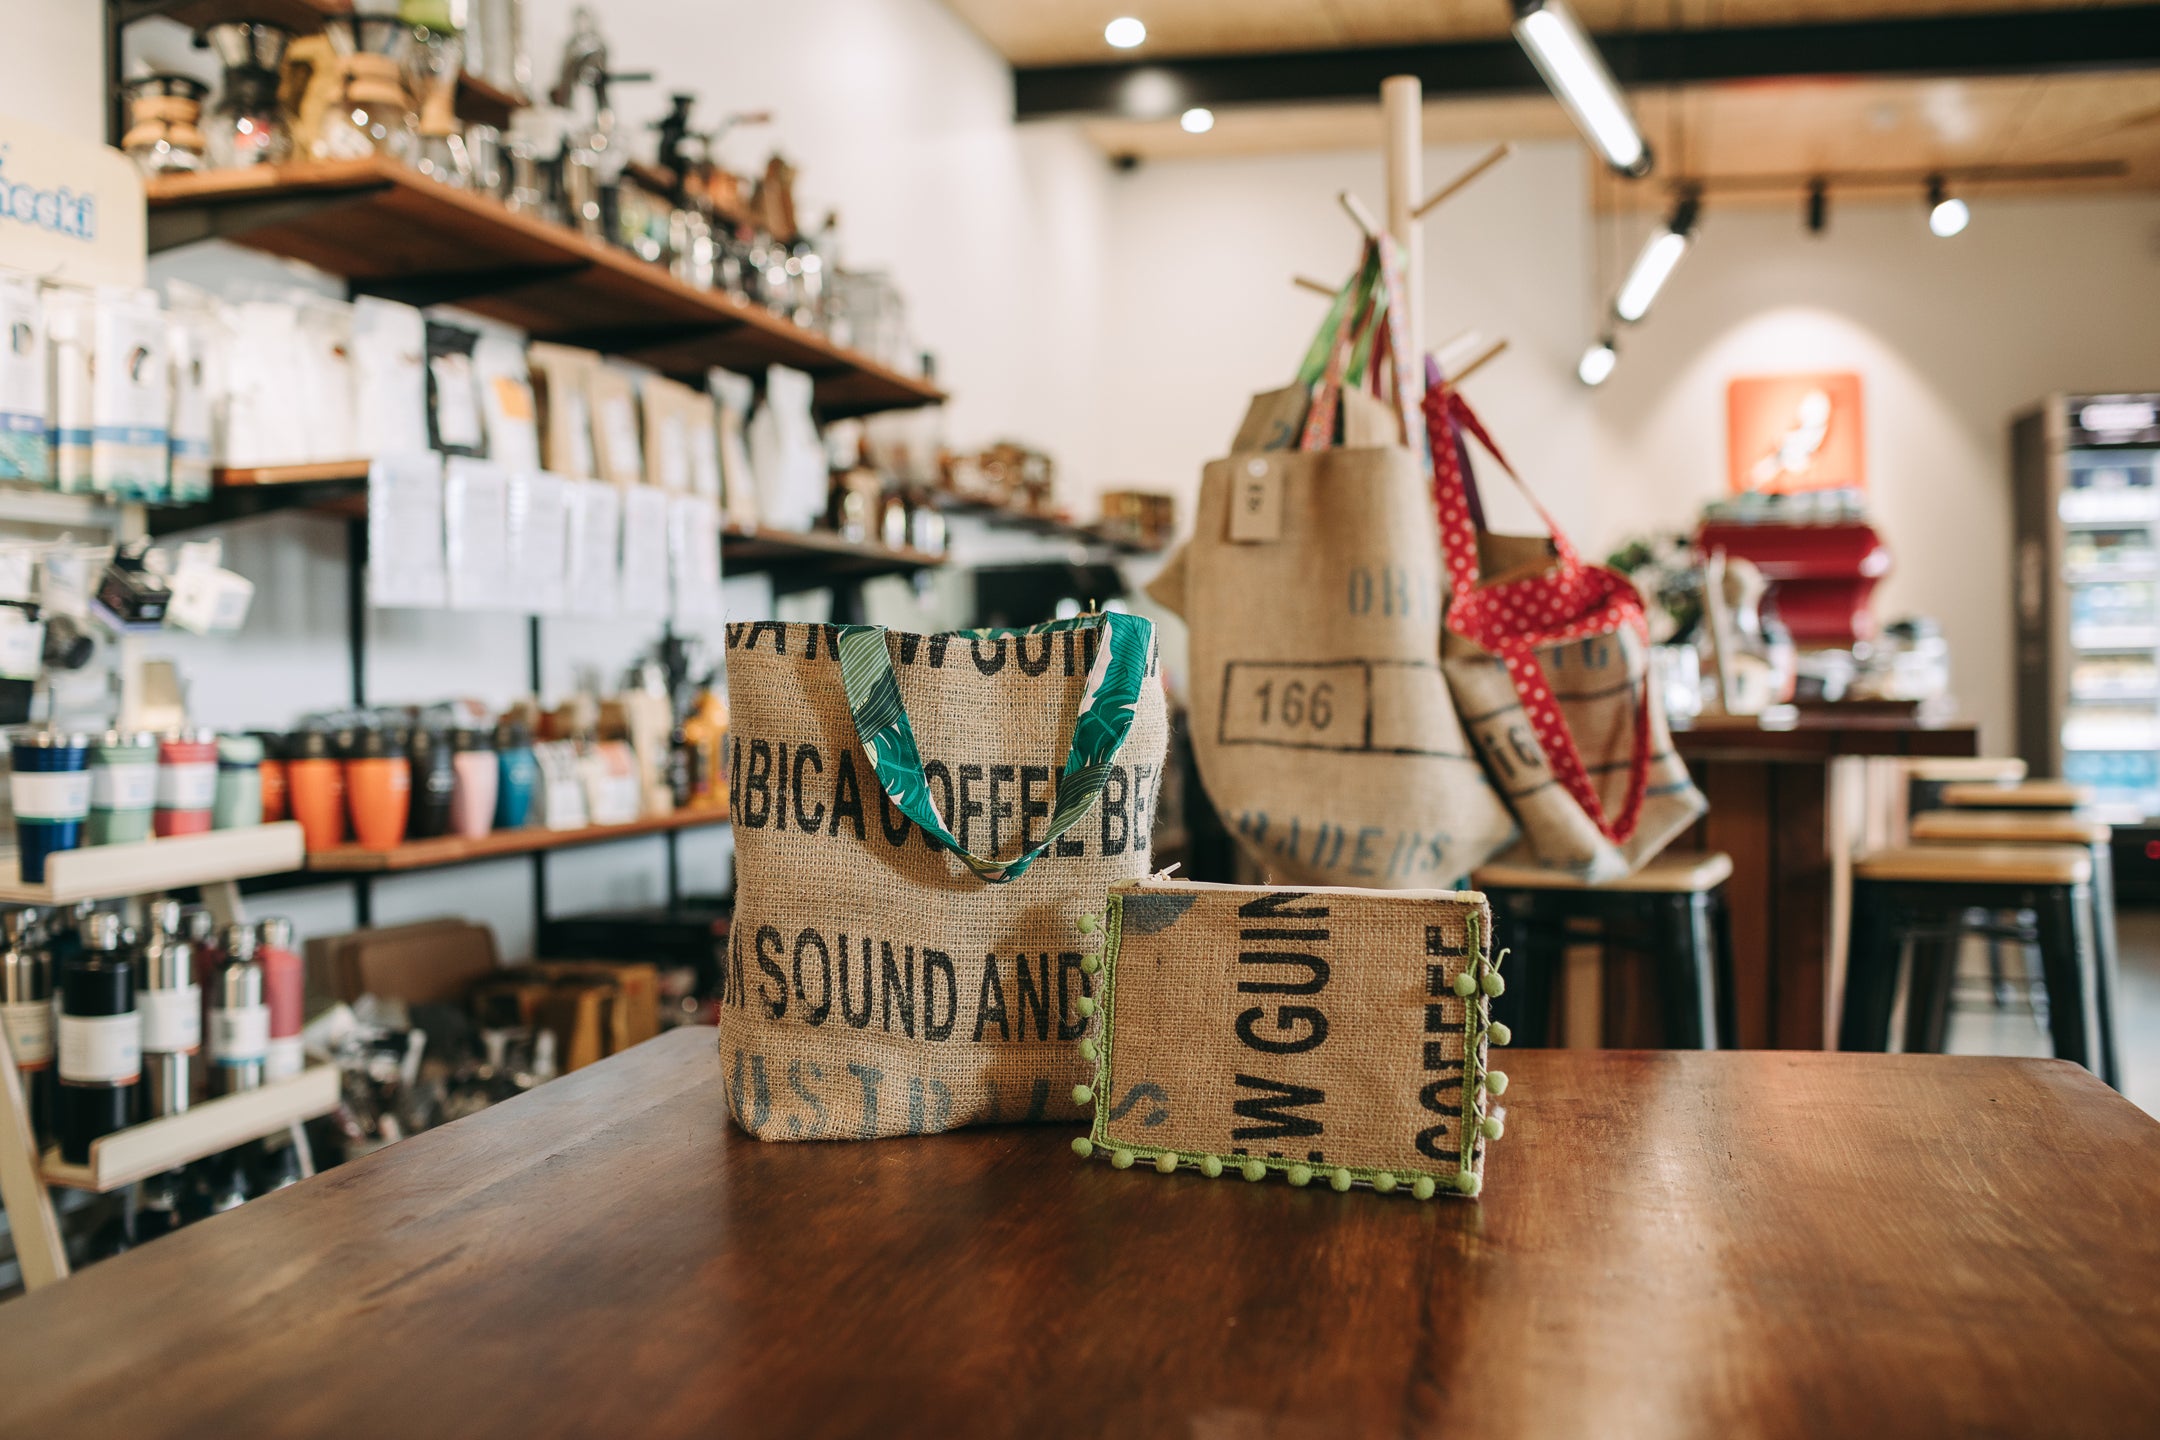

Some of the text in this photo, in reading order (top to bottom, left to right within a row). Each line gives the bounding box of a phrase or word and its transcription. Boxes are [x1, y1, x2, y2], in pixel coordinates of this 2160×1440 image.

[1255, 682, 1335, 729] 166
[755, 925, 957, 1042] SOUND
[973, 952, 1092, 1042] AND
